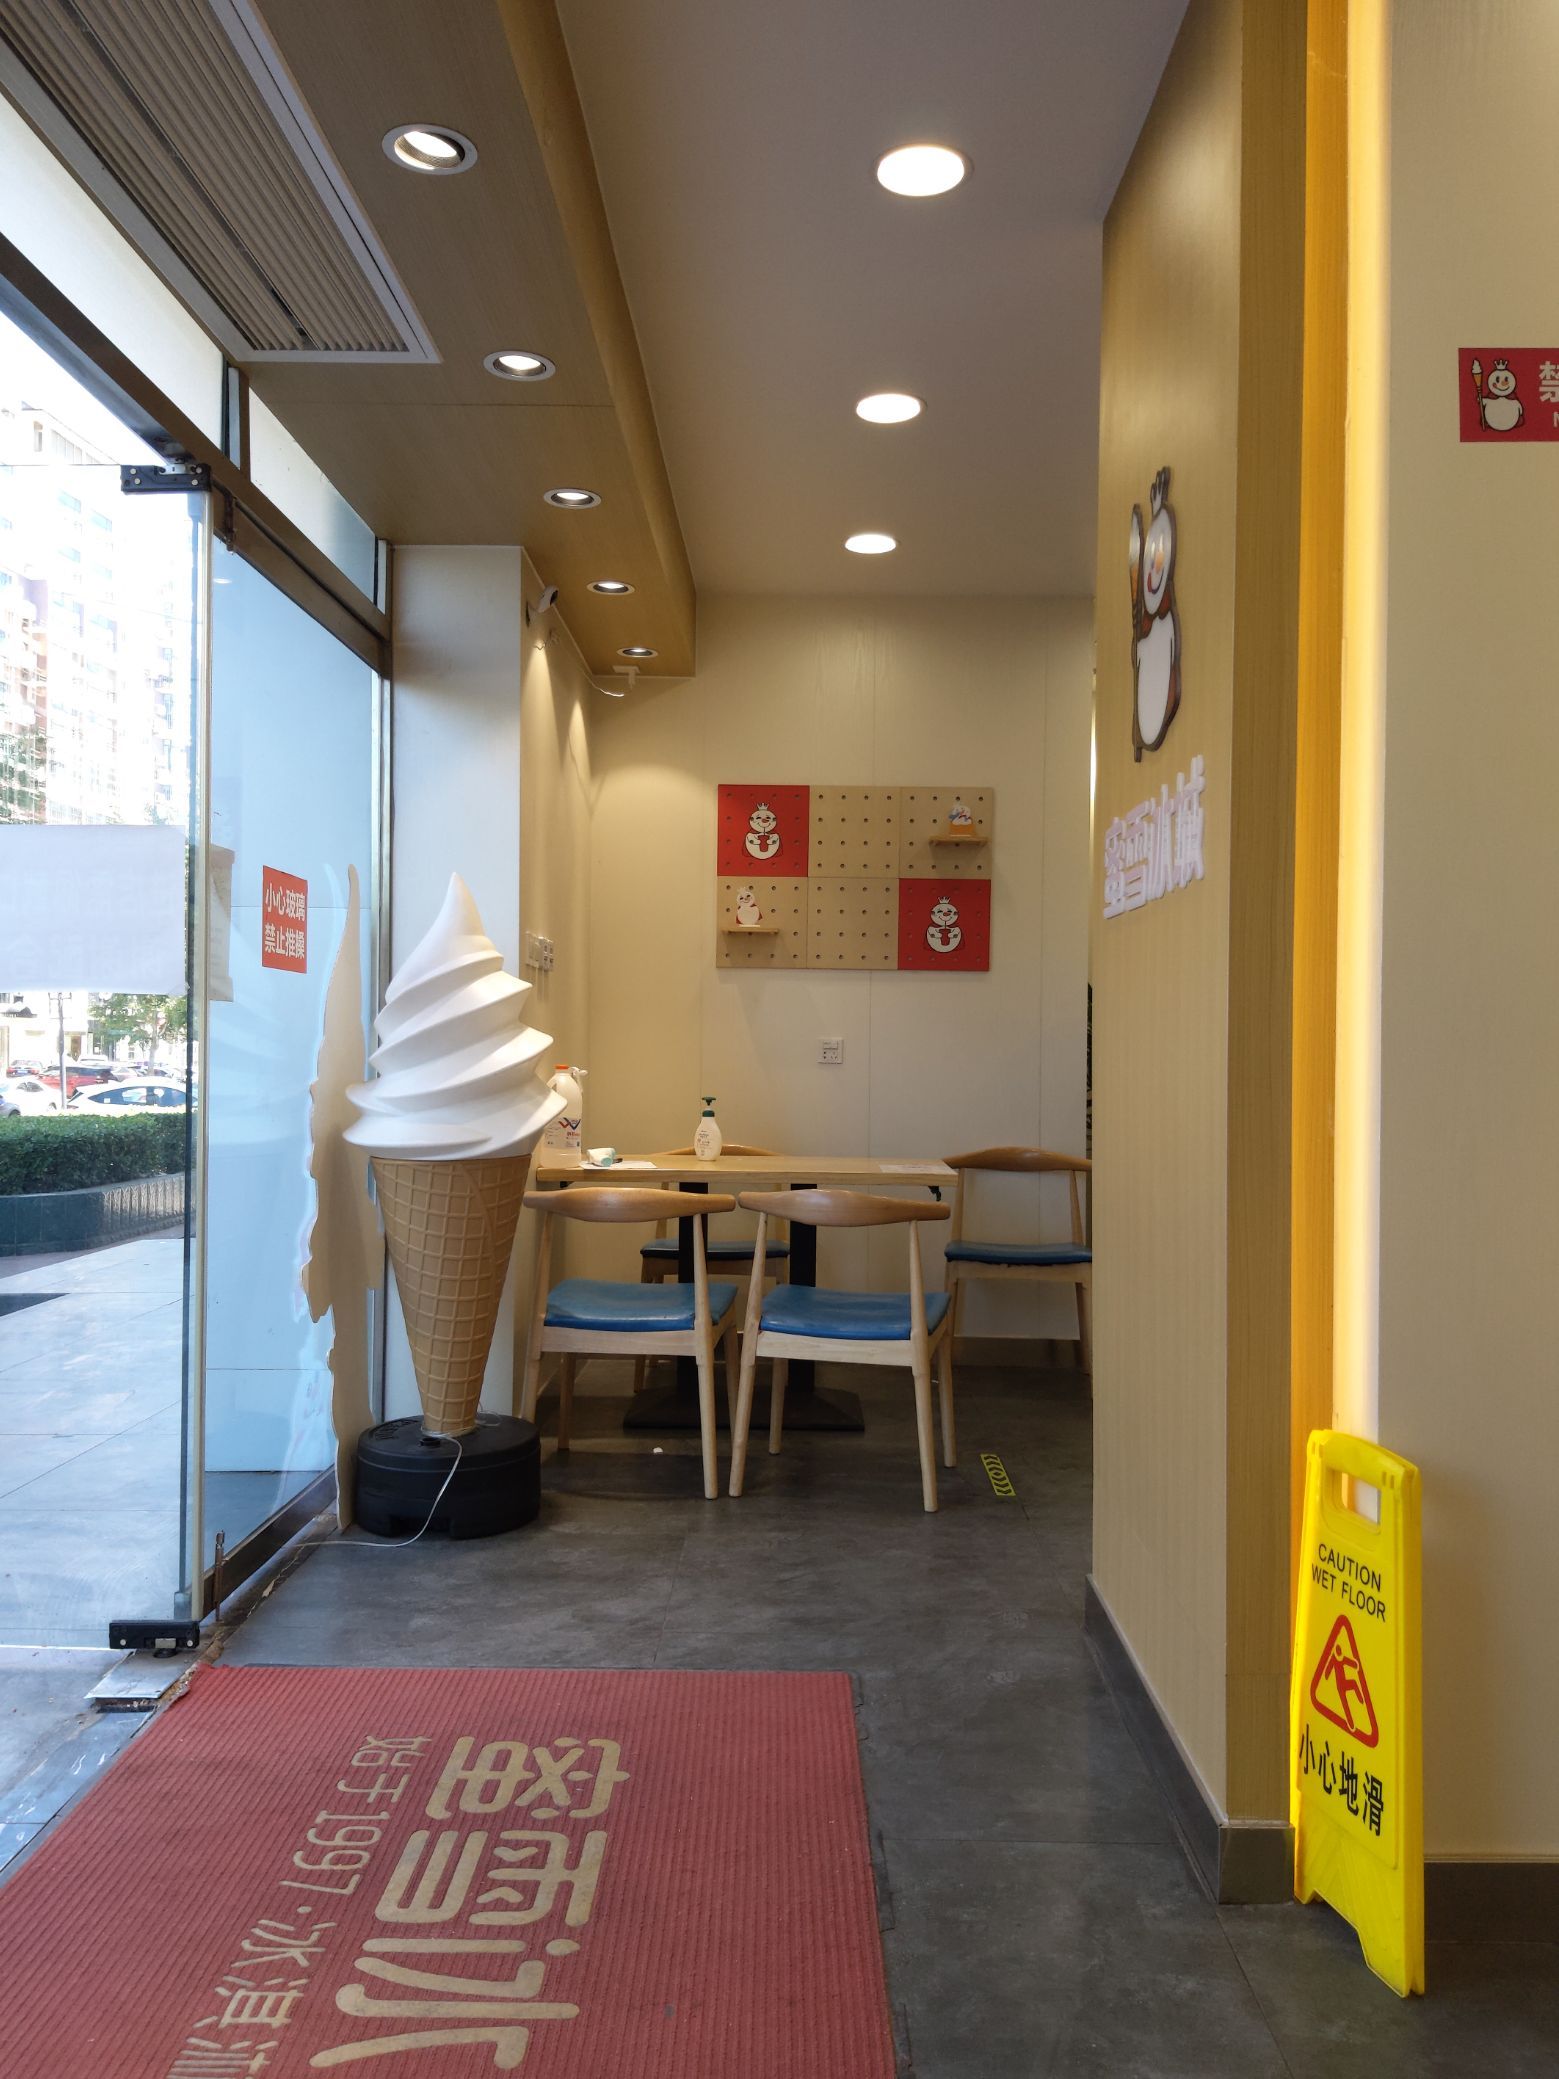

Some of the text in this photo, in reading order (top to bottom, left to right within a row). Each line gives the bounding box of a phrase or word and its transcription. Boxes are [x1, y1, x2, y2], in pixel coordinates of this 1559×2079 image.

[1103, 754, 1206, 920] 蜜雪冰城
[265, 882, 306, 922] 小心玻璃
[264, 922, 305, 960] 禁止推搡
[1311, 1563, 1386, 1623] WET FLOOR
[1318, 1543, 1382, 1593] CAUTION
[1299, 1723, 1384, 1837] 小心地滑
[309, 1735, 631, 2070] 蜜雪冰
